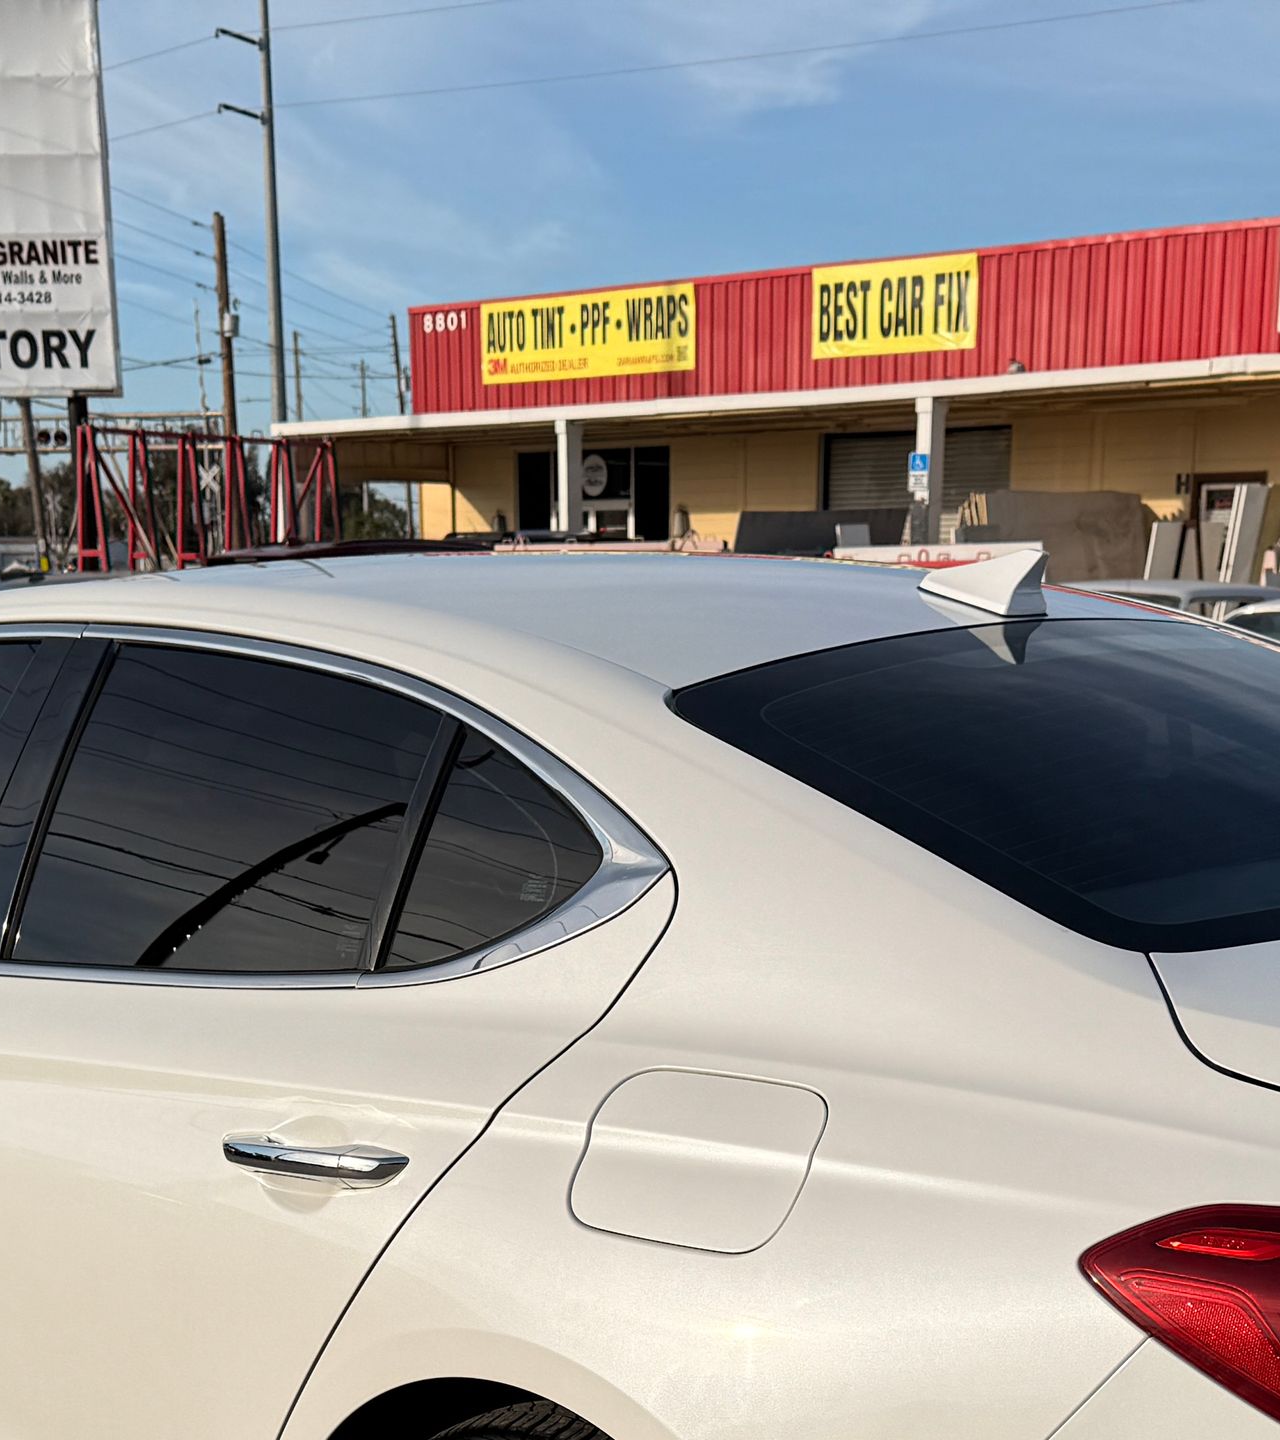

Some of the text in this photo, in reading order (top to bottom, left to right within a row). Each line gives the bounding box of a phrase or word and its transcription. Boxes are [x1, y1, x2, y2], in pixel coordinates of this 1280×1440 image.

[1, 271, 35, 286] Walls
[40, 272, 48, 285] &
[52, 270, 82, 285] More
[819, 270, 970, 342] BEST CAR FIX
[423, 311, 467, 334] 8801
[487, 293, 689, 354] AUTO TINT PPF WRAPS
[488, 357, 508, 376] 3M
